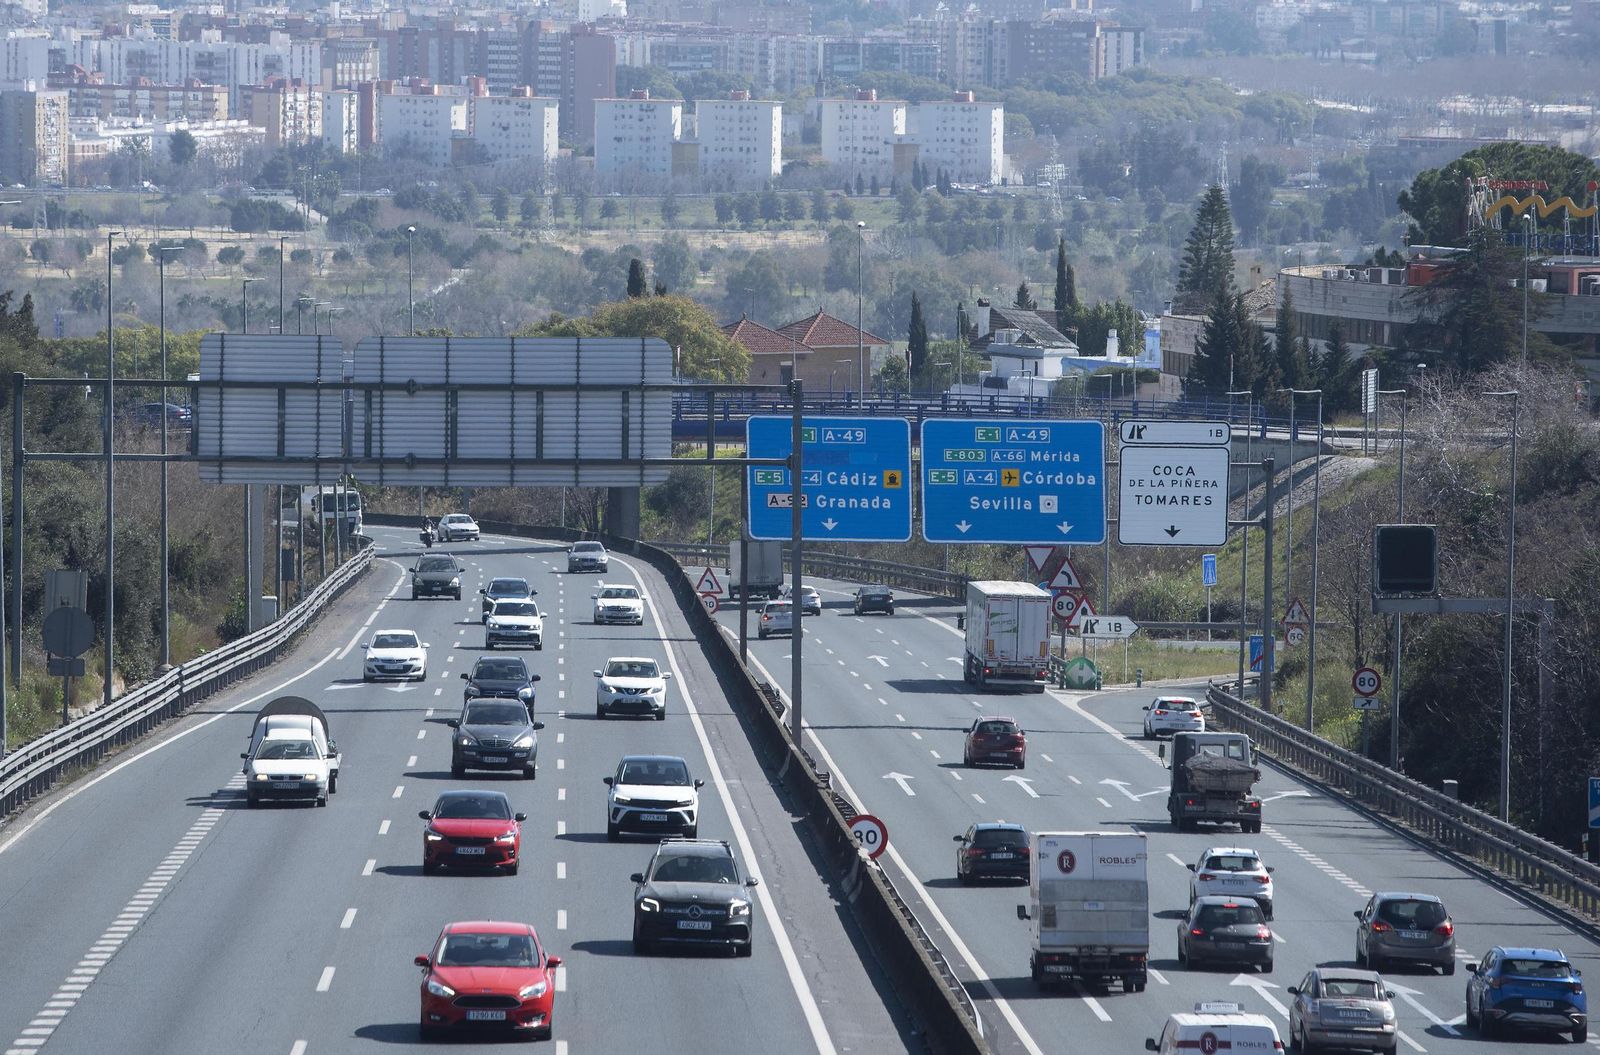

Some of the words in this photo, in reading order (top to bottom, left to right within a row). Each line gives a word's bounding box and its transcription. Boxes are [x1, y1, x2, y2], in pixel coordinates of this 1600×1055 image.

[825, 430, 864, 441] A-49
[977, 430, 1000, 440] E-1
[1009, 430, 1048, 440] A-49
[1209, 429, 1223, 438] 1B
[946, 451, 984, 460] E-803
[993, 451, 1024, 460] A-66
[1031, 450, 1080, 462] Mérida
[1152, 465, 1196, 476] COCA
[756, 472, 782, 482] E-5
[827, 471, 877, 486] Cádiz
[930, 472, 956, 482] E-5
[966, 472, 994, 482] A-4
[1022, 472, 1096, 485] Córdoba
[1172, 478, 1218, 488] PIÑERA
[816, 494, 891, 508] Granada
[970, 496, 1032, 510] Sevilla
[1135, 494, 1213, 506] TOMARES
[1056, 602, 1074, 610] 80
[1108, 622, 1122, 632] 1B
[1358, 677, 1376, 687] 80
[1100, 856, 1136, 864] ROBLES
